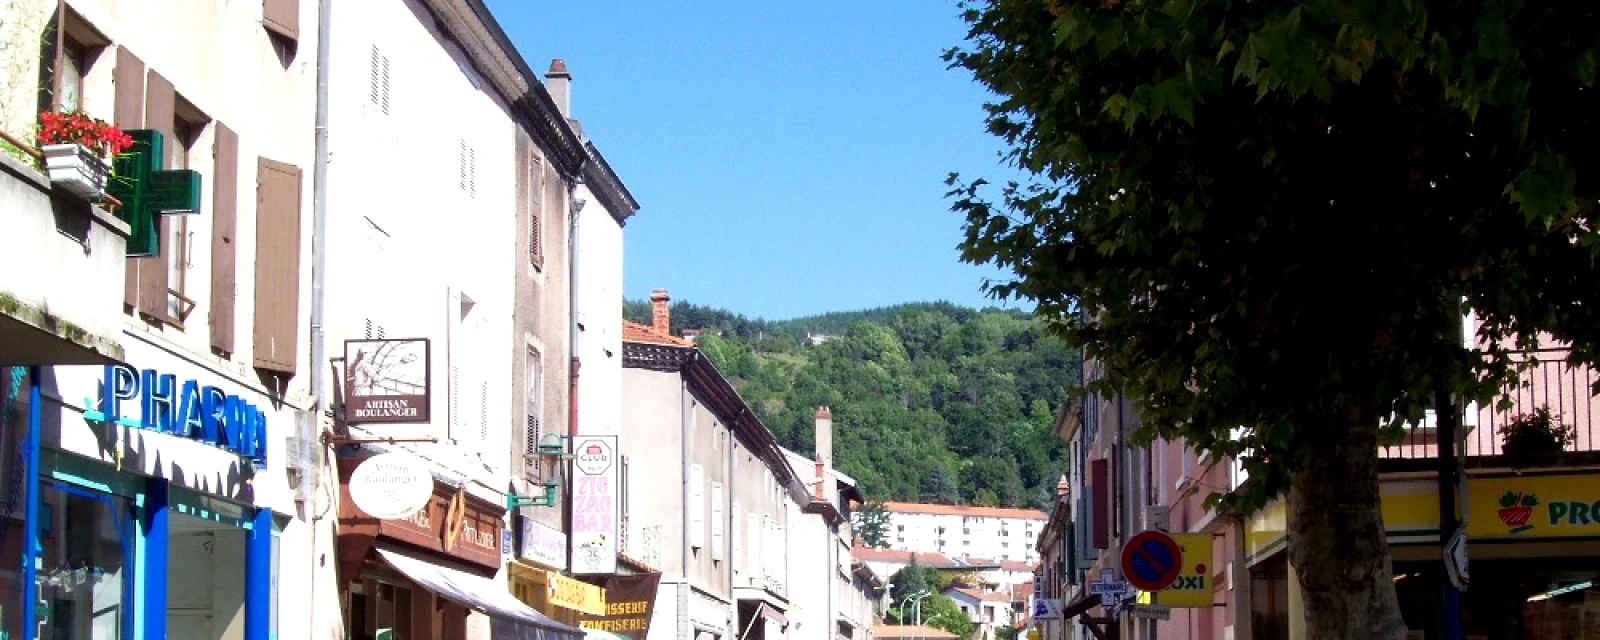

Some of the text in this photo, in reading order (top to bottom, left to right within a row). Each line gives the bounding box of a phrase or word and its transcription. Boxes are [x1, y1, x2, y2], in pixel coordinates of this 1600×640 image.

[364, 399, 409, 409] ARTISAN
[355, 407, 418, 417] BOULANGER
[580, 453, 607, 462] CLUB
[578, 477, 608, 495] ZIG
[574, 495, 611, 513] ZAG
[574, 513, 613, 532] BAR
